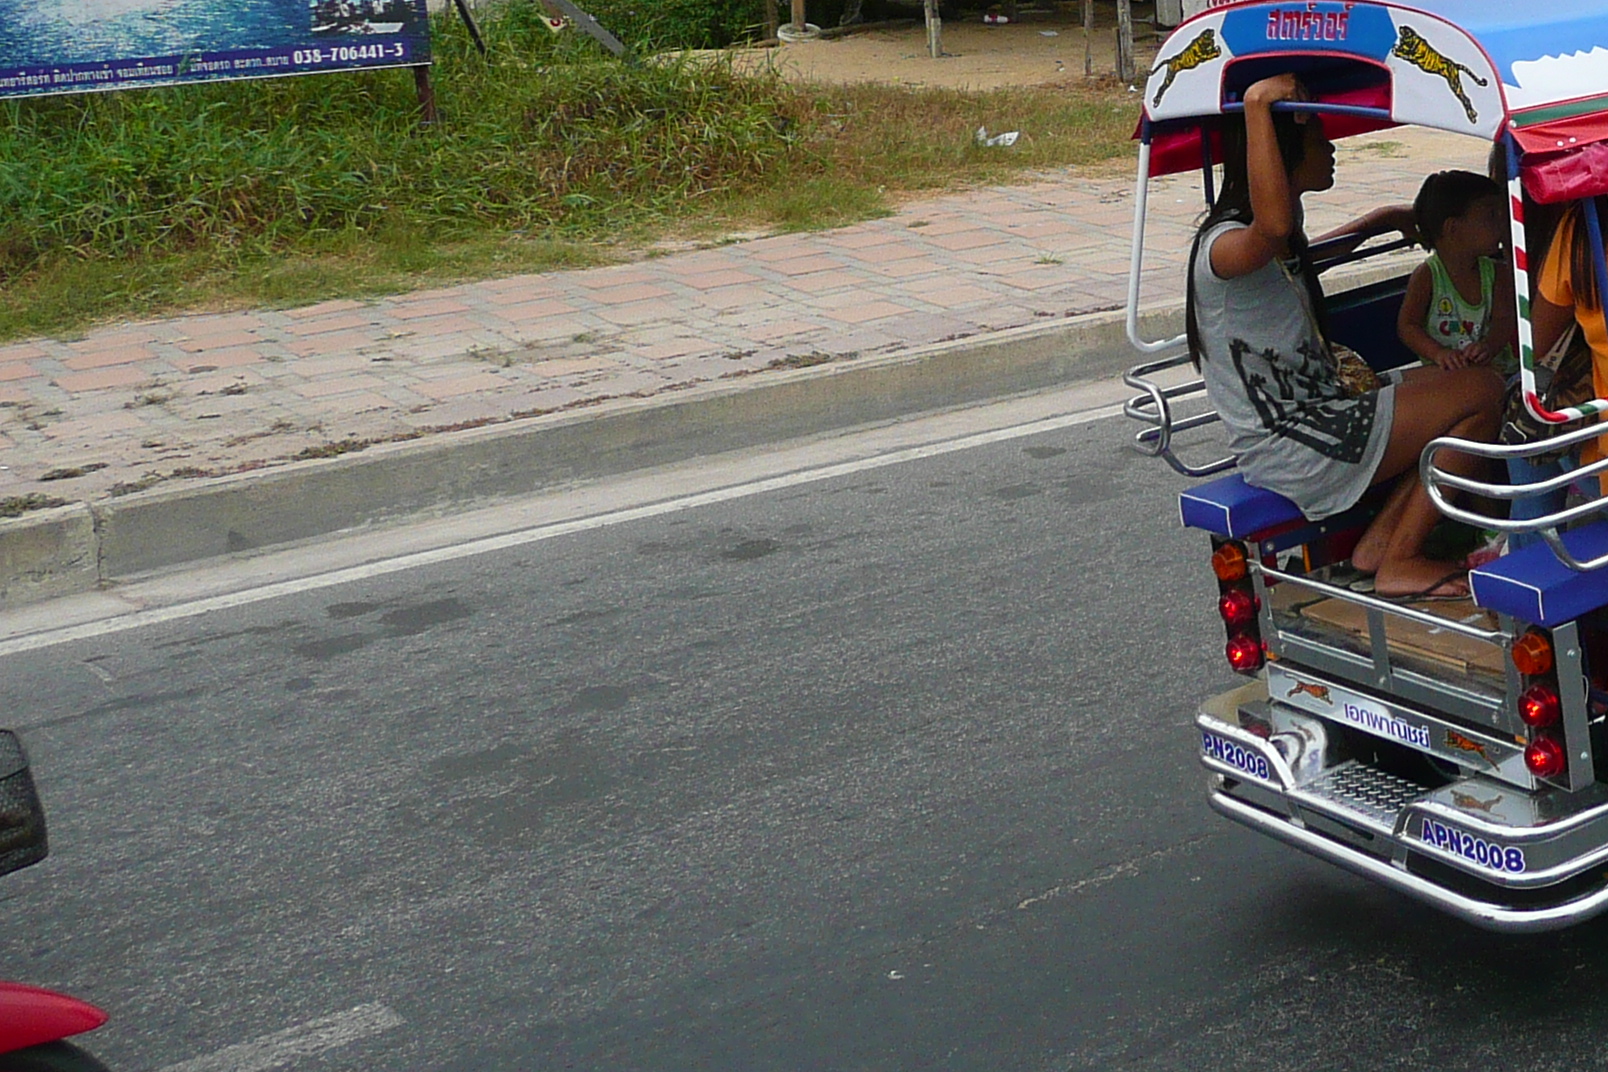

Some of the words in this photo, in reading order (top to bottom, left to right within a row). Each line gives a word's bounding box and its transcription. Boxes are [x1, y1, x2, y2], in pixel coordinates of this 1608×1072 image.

[294, 43, 403, 65] 038-706441-3
[1344, 703, 1430, 748] เอกพาณิชย์
[1421, 817, 1526, 873] APN2008
